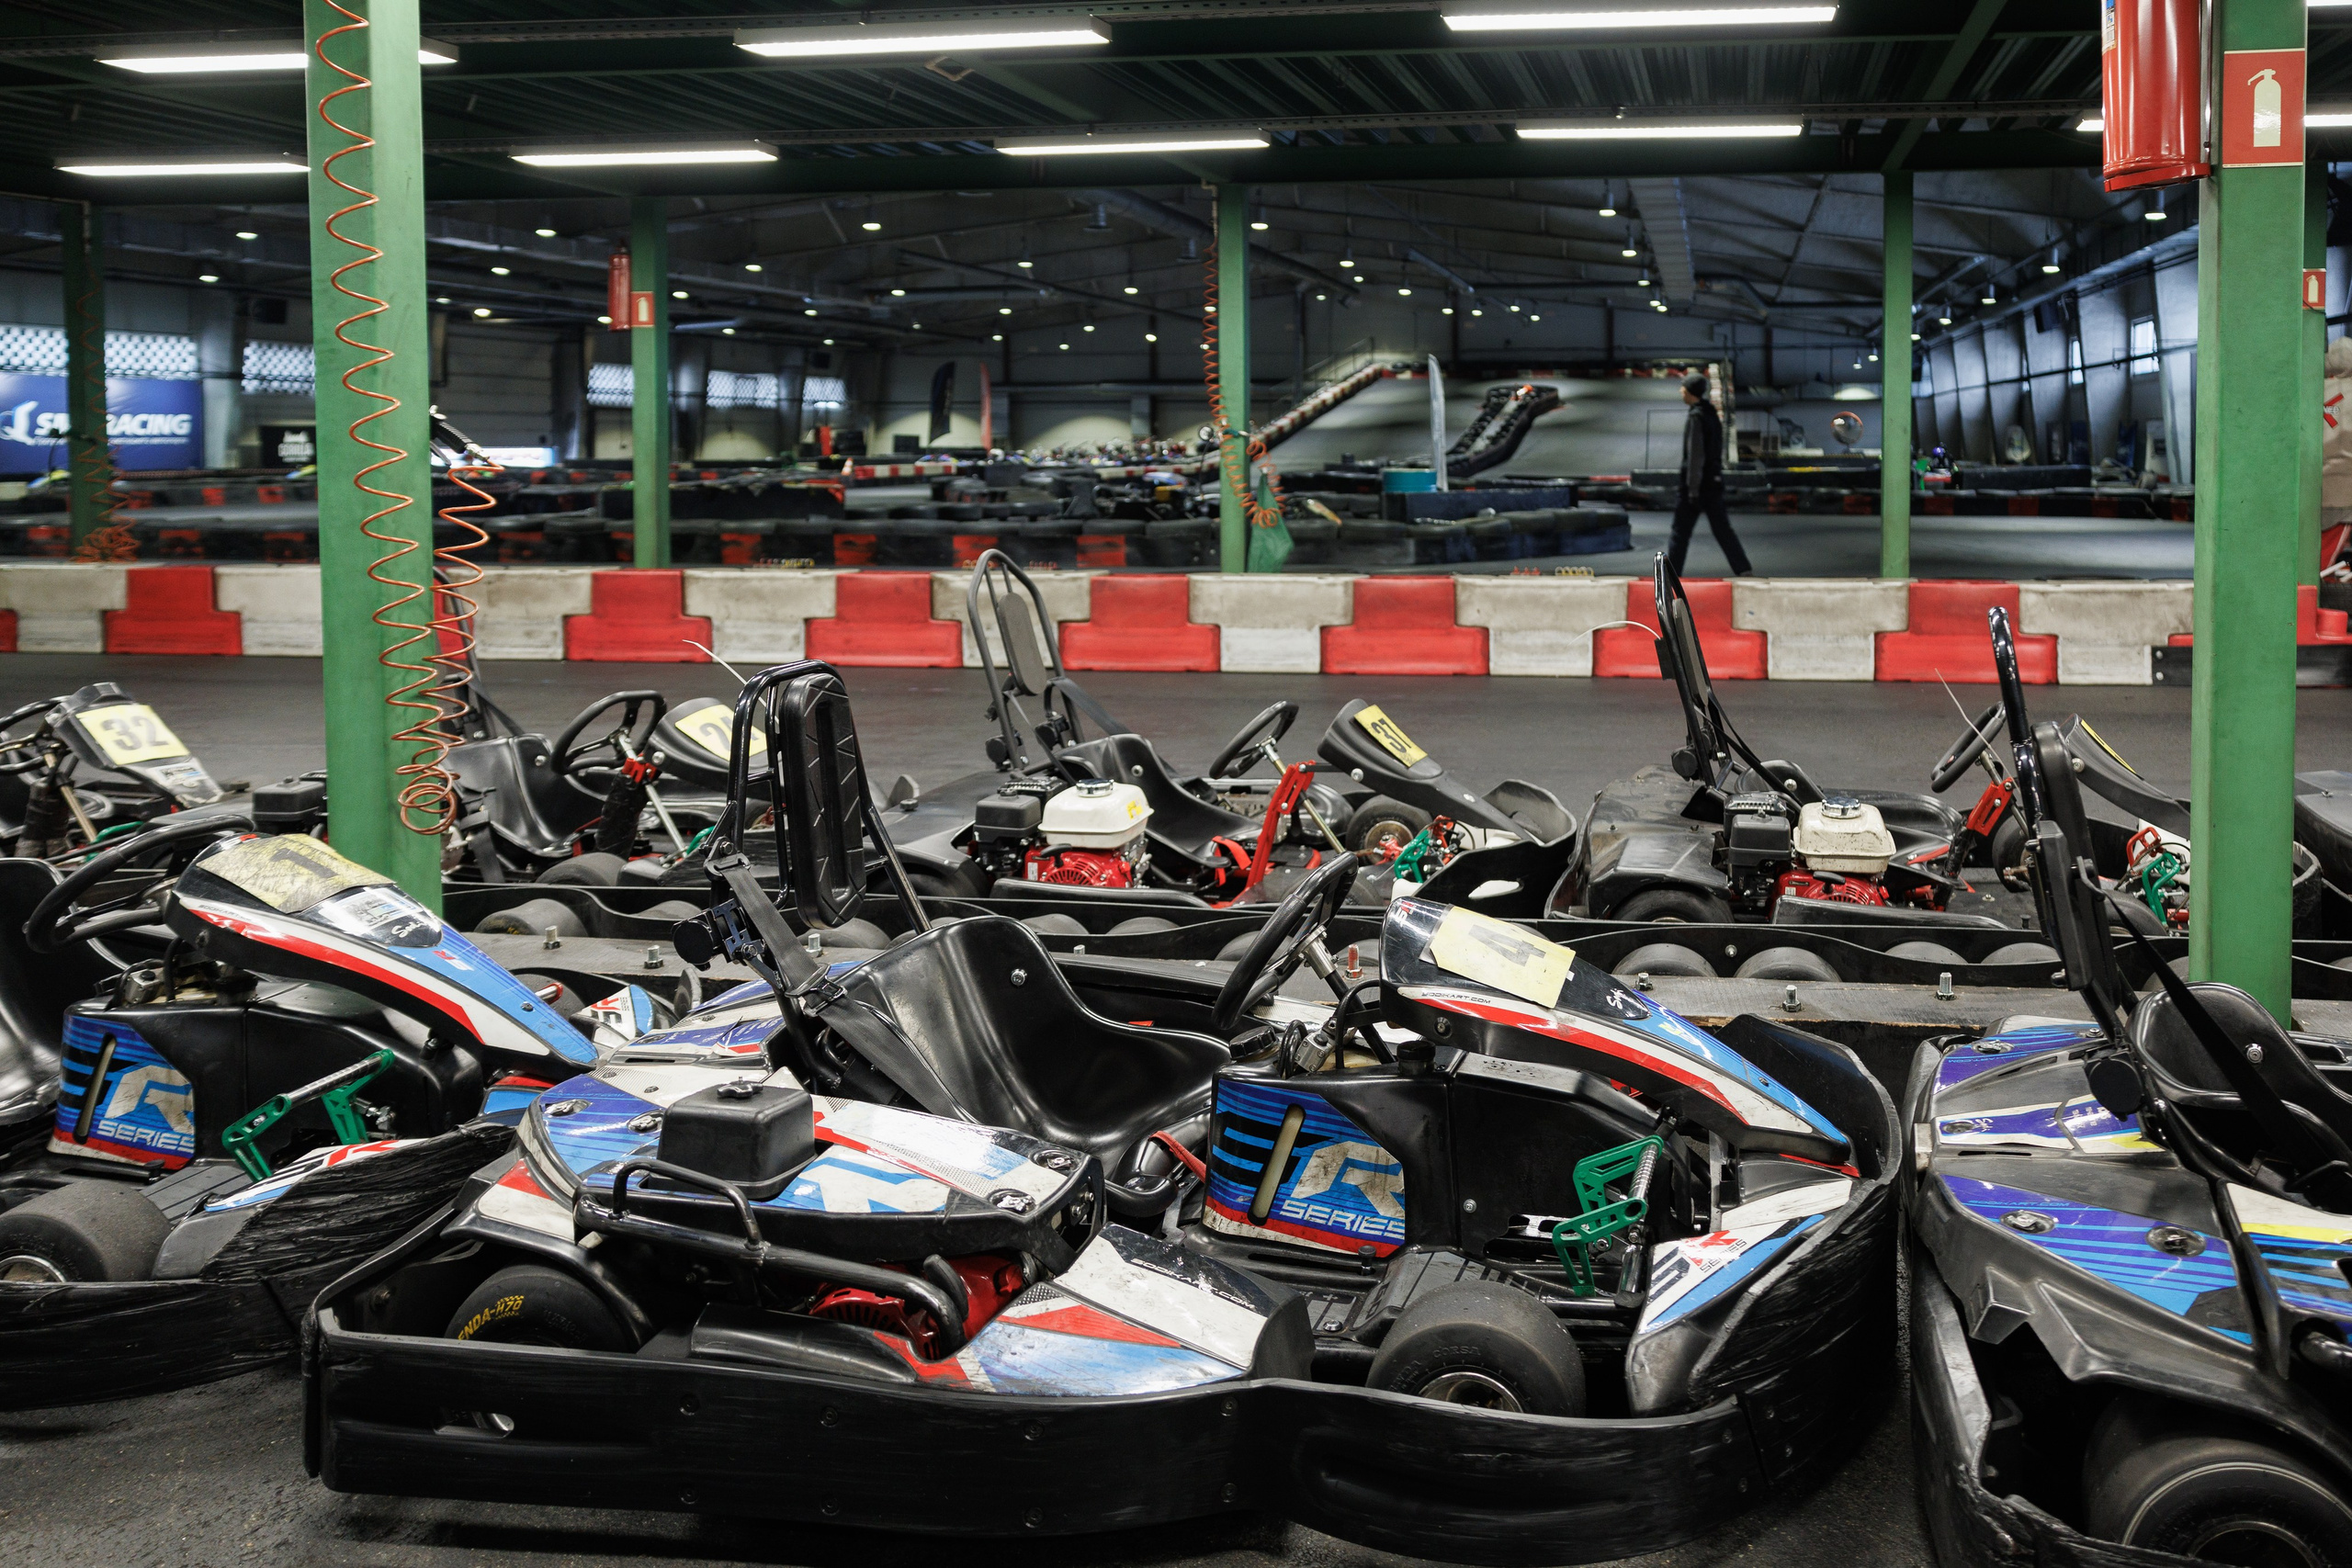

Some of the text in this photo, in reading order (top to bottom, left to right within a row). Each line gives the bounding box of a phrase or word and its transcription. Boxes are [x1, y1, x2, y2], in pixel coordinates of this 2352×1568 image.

[101, 716, 169, 751] 32
[1371, 718, 1411, 753] 37
[269, 847, 338, 878] 1
[1468, 924, 1546, 967] 4
[96, 1120, 195, 1154] SERIES
[1279, 1200, 1406, 1240] SERIES
